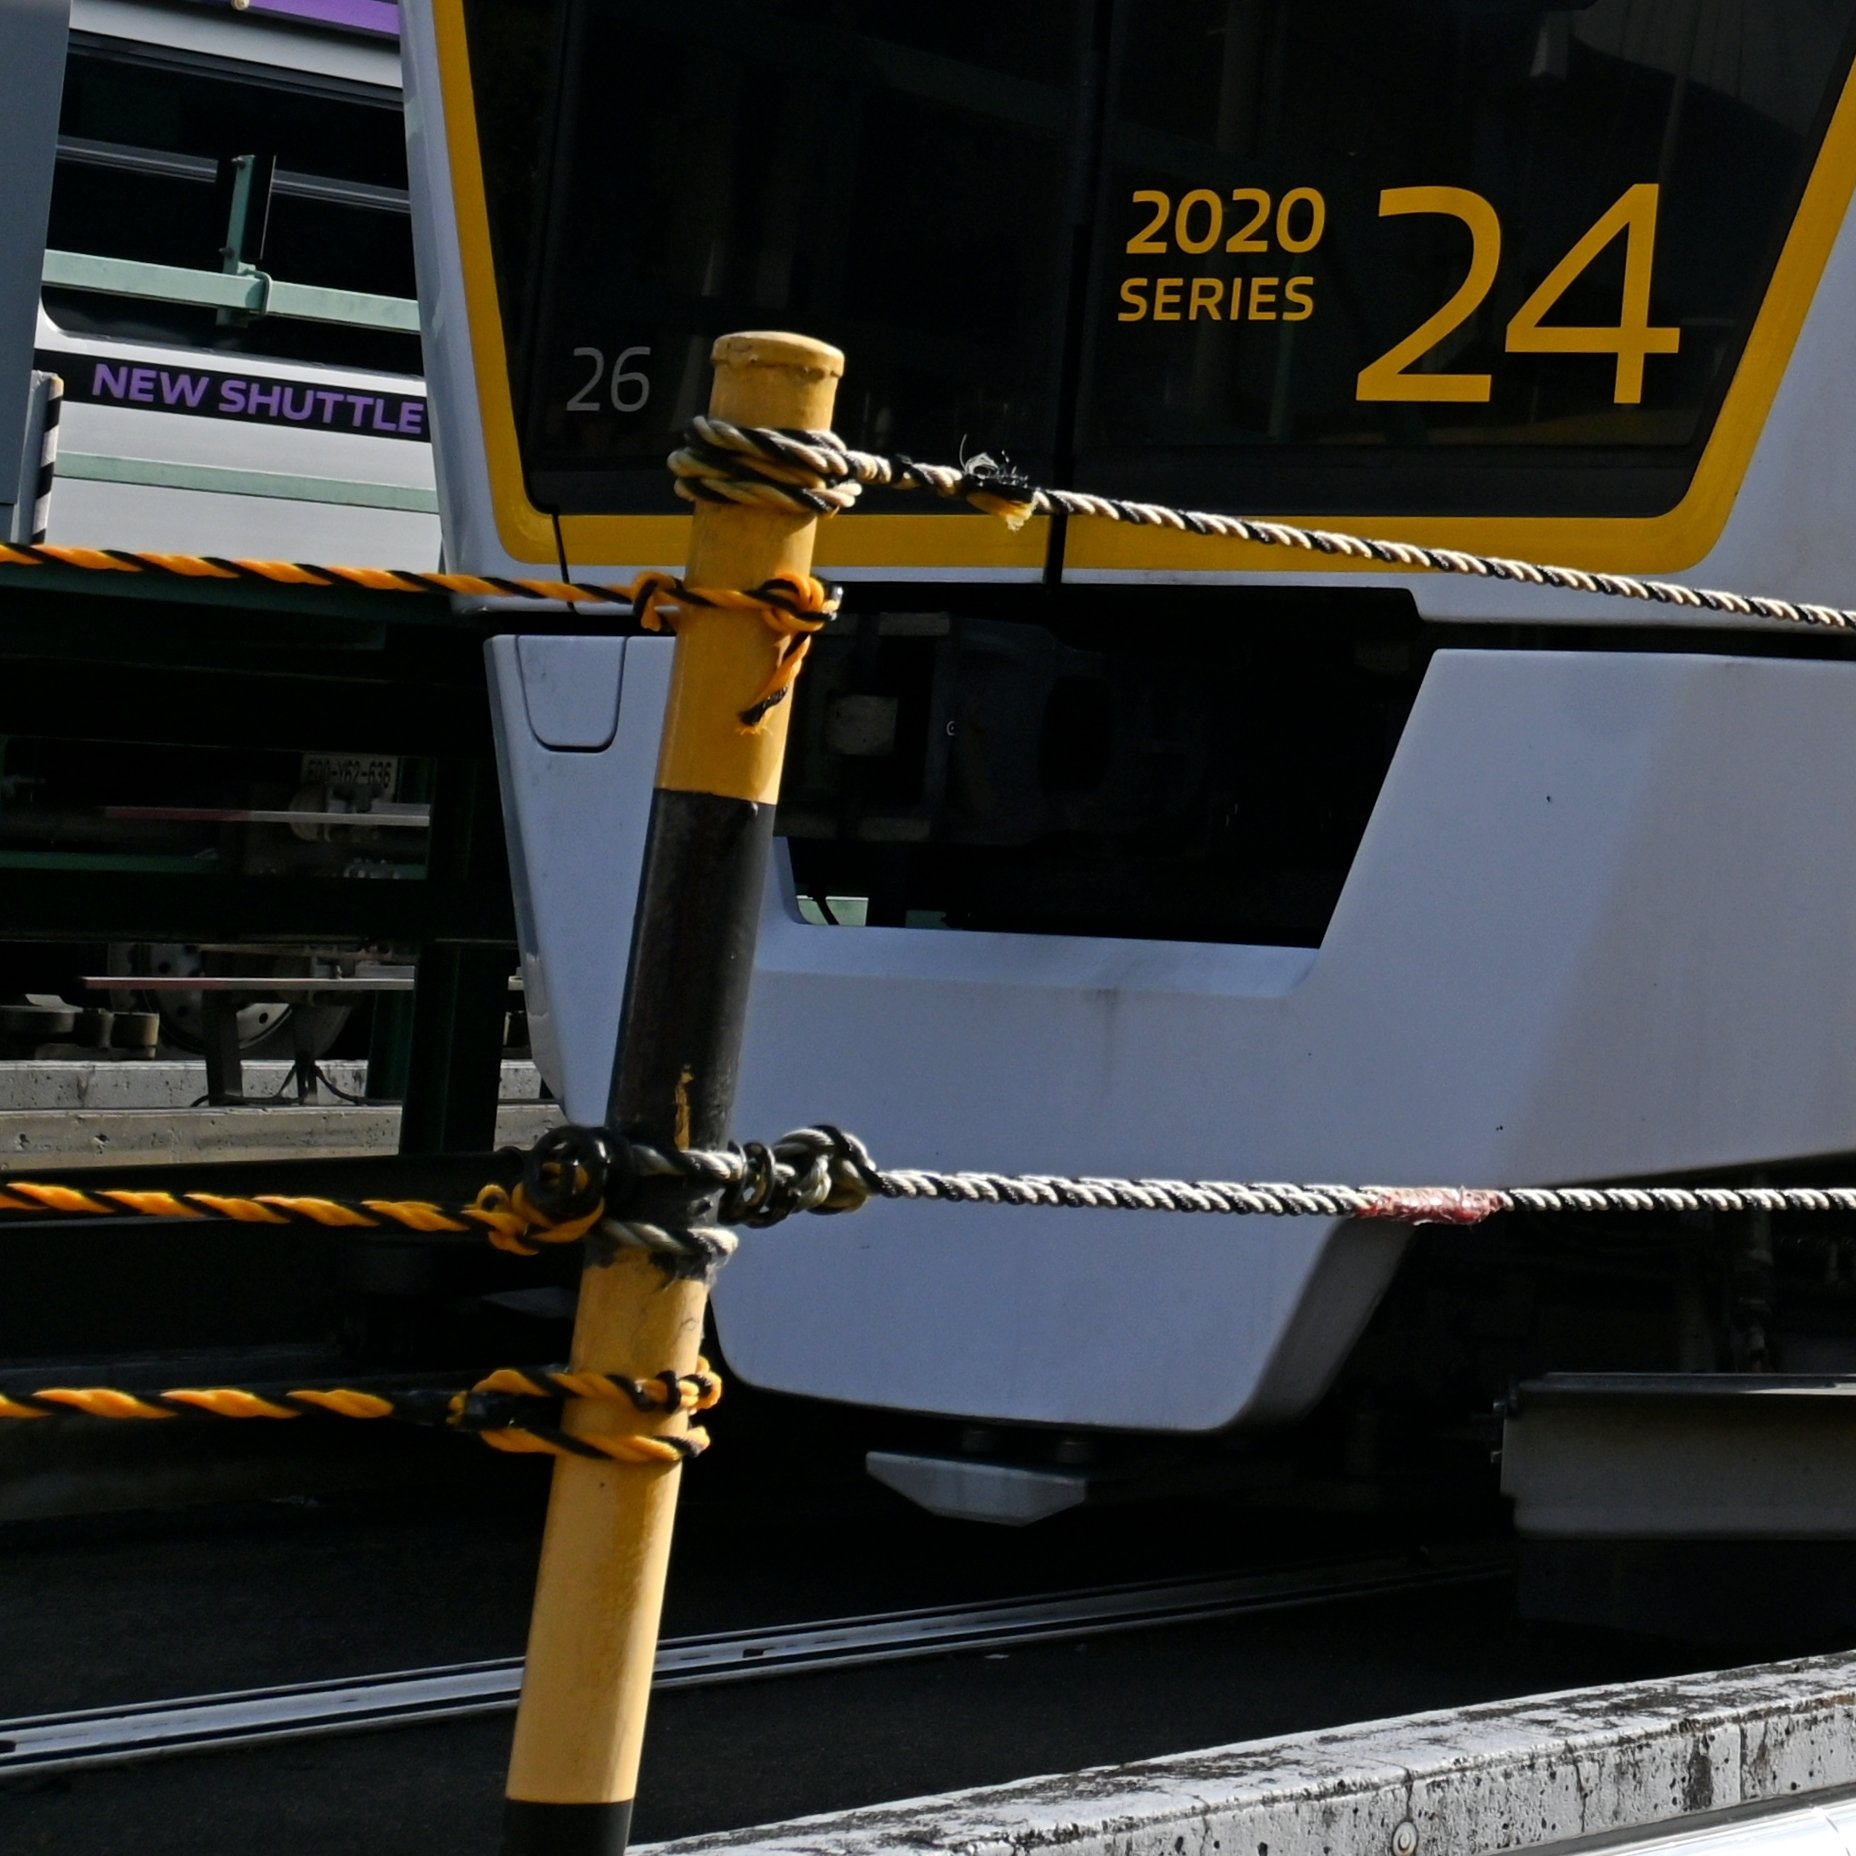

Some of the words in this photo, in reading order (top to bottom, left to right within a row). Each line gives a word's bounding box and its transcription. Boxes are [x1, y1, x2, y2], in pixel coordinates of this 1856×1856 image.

[1126, 187, 1326, 254] 2020
[1117, 276, 1315, 322] SERIES
[1355, 183, 1681, 404] 24
[91, 363, 210, 408] NEW
[218, 379, 425, 435] SHUTTLE
[566, 346, 651, 413] 26
